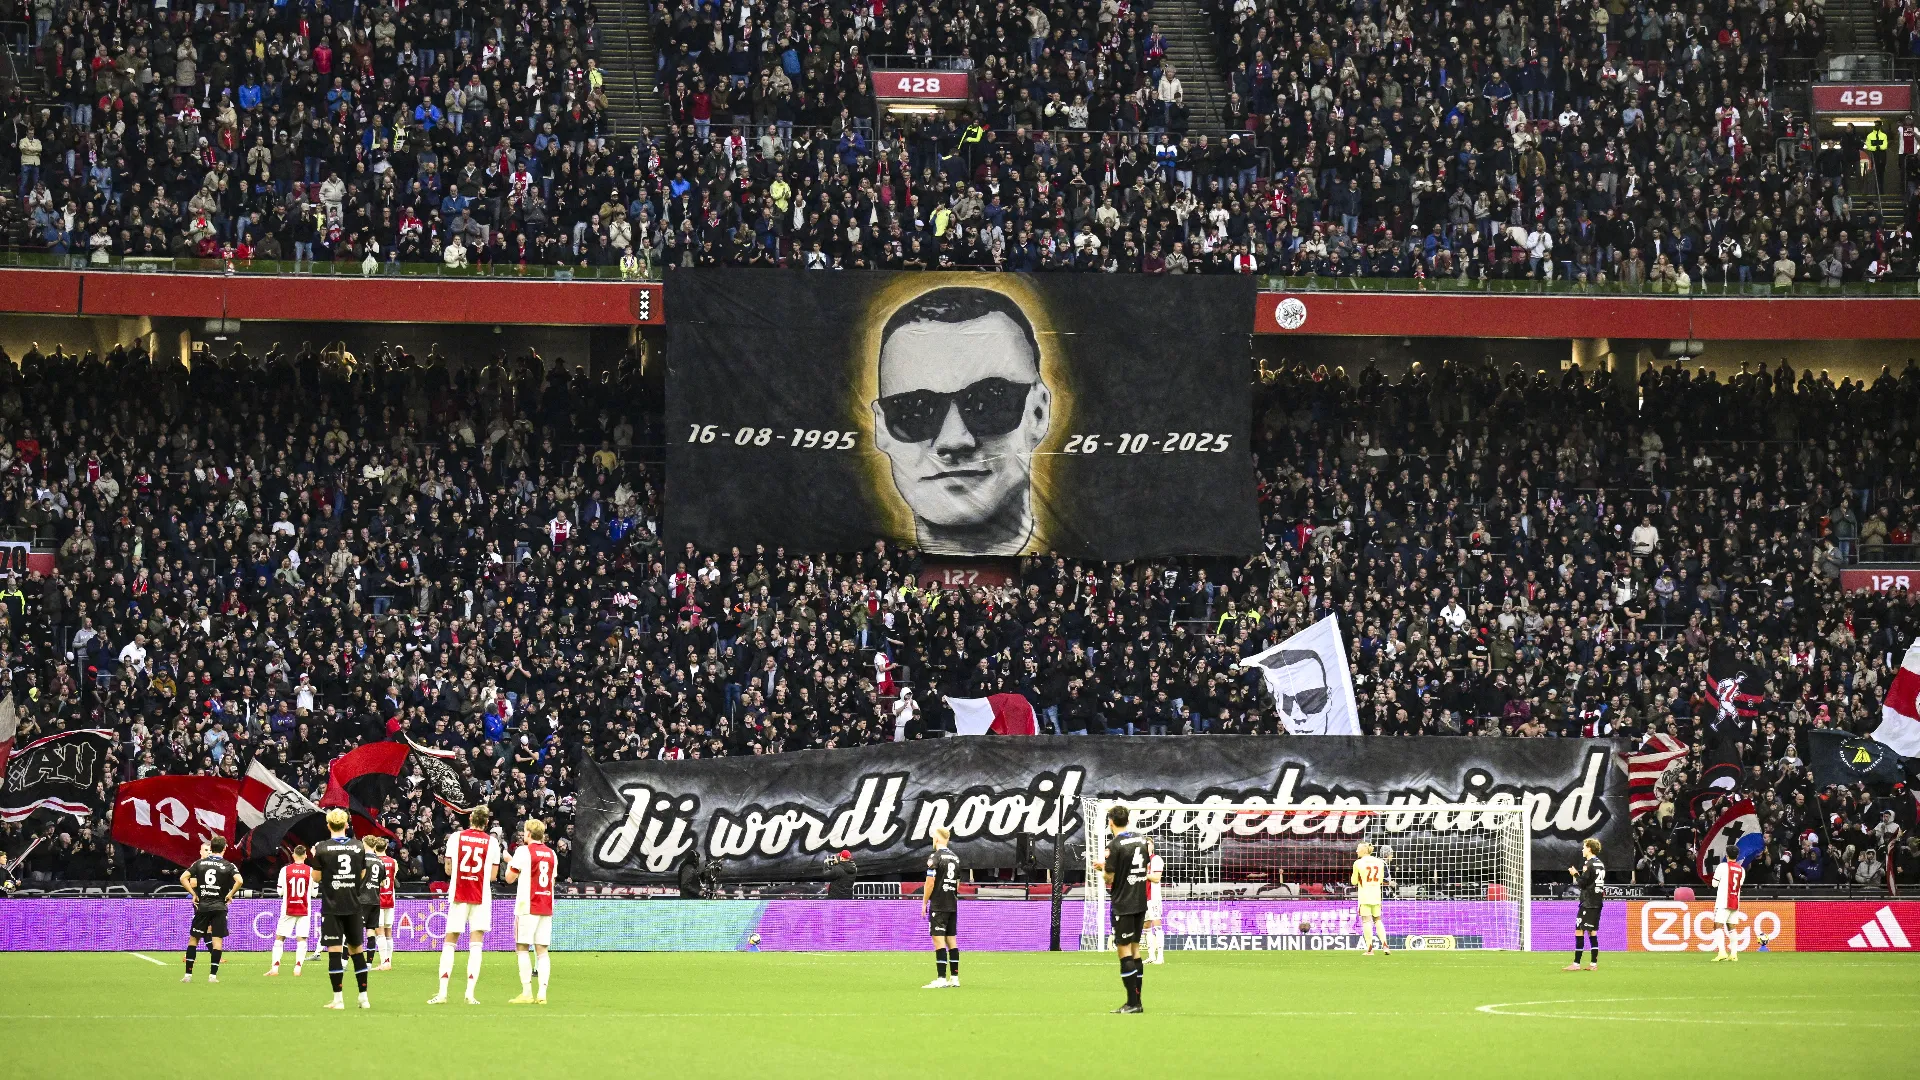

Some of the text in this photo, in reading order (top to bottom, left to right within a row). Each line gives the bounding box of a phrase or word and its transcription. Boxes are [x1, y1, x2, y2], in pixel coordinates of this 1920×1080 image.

[898, 77, 941, 93] 428
[1840, 90, 1883, 106] 429
[942, 569, 980, 586] 127
[1871, 575, 1910, 591] 128
[599, 788, 693, 873] Jij
[709, 776, 904, 857] wordt
[910, 770, 1082, 841] nooit
[1385, 752, 1603, 832] vriend
[337, 853, 352, 875] 3
[459, 845, 484, 874] 25
[1131, 846, 1145, 869] 4
[204, 868, 217, 885] 6
[371, 863, 380, 879] 9
[538, 861, 550, 888] 8
[946, 862, 956, 880] 8
[1365, 865, 1380, 883] 22
[289, 876, 306, 898] 10
[1732, 873, 1739, 891] 5
[1183, 935, 1263, 950] ALLSAFE
[1267, 935, 1306, 950] MINI
